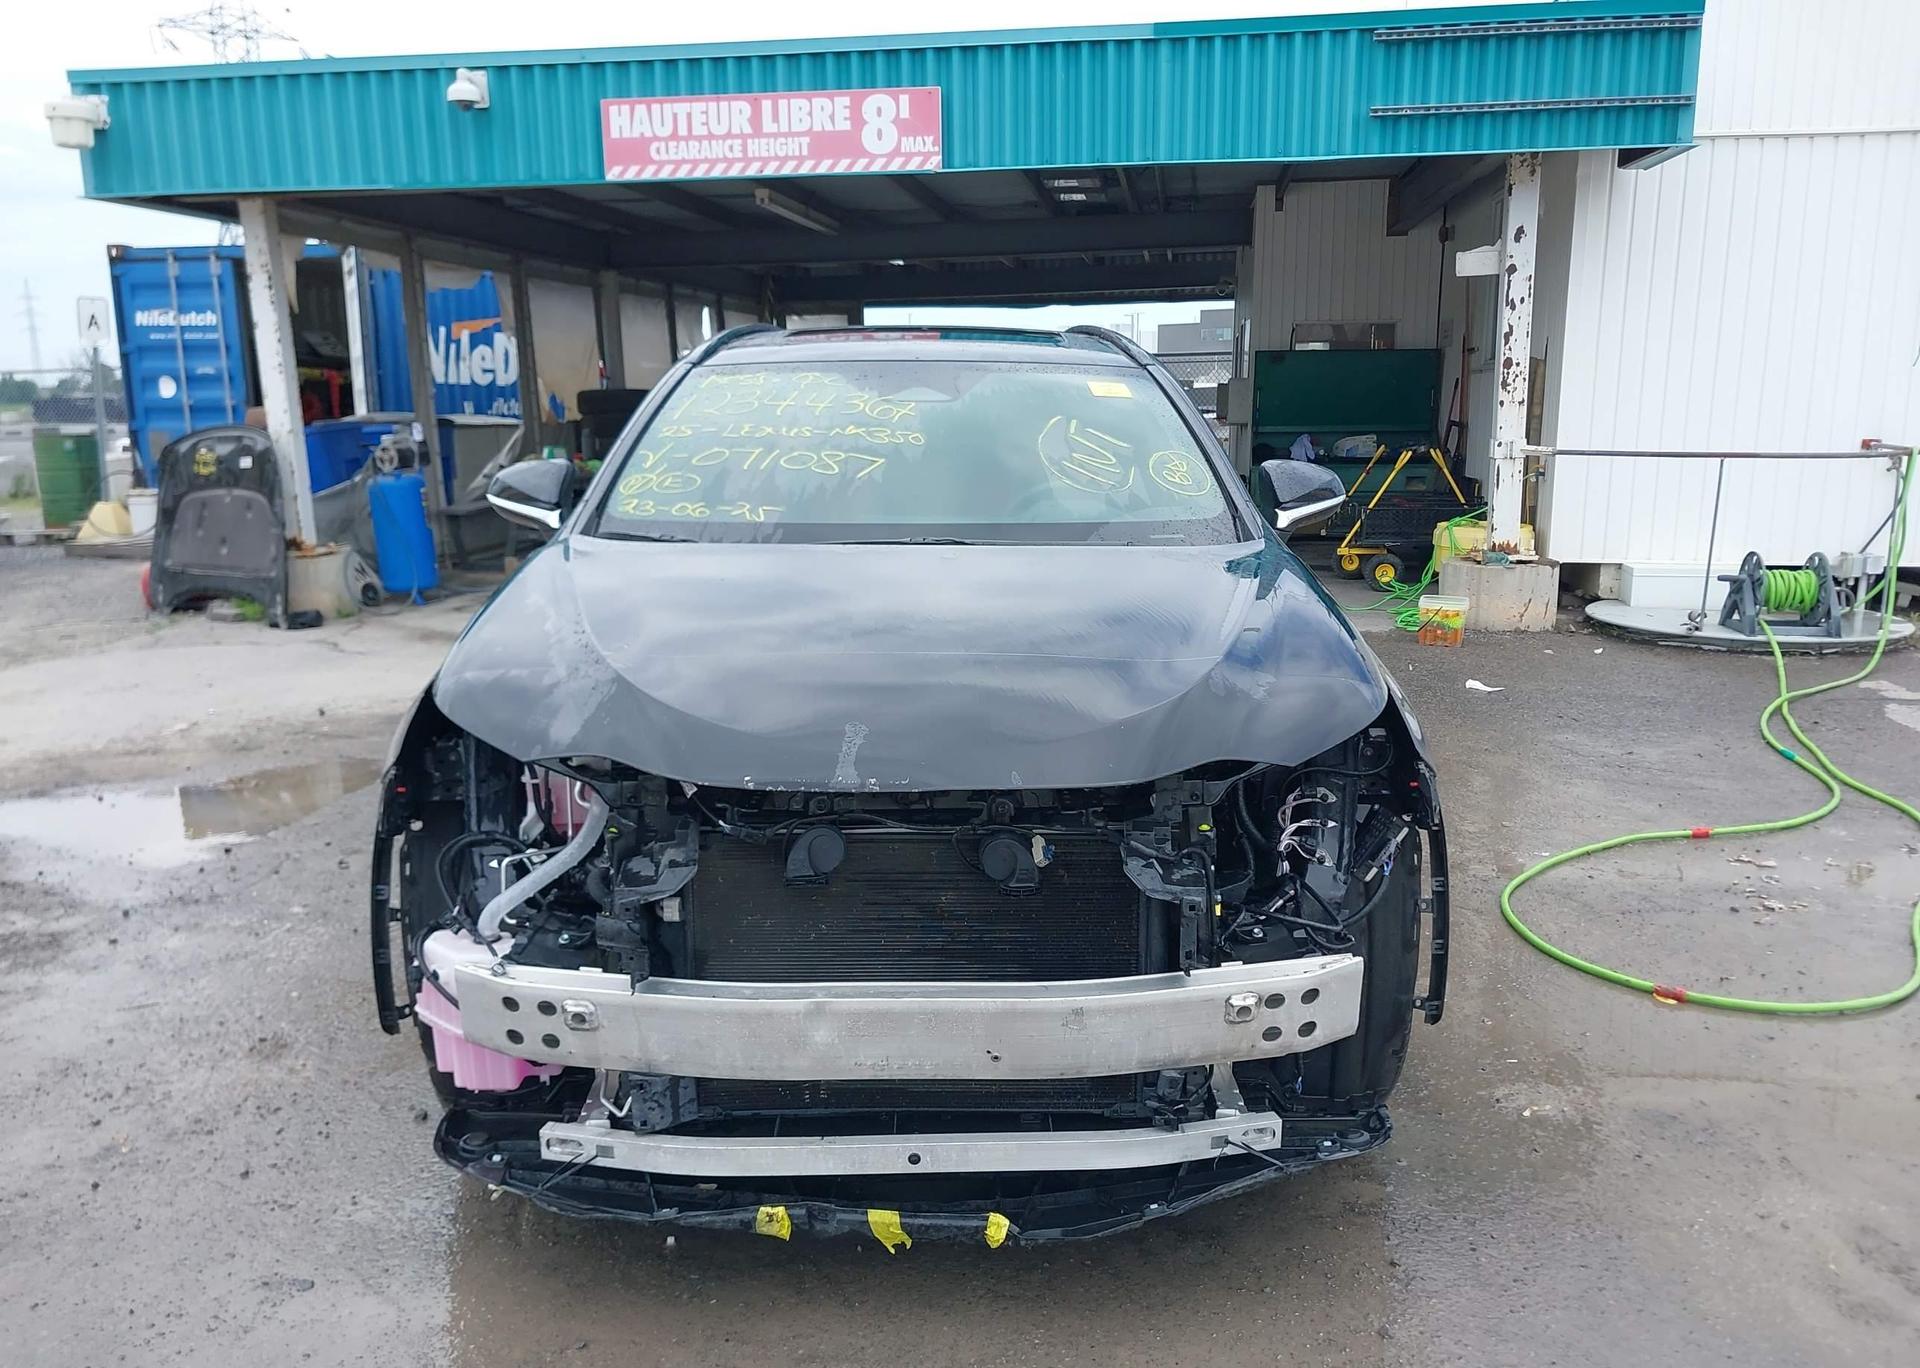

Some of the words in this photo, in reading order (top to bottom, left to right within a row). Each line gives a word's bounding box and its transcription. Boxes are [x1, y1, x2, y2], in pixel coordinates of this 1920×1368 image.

[608, 101, 753, 138] HAUTEUR
[761, 97, 852, 133] LIBRE
[649, 140, 743, 161] CLEARANCE
[747, 137, 811, 158] HEIGHT
[900, 135, 940, 153] MAX.
[88, 313, 101, 331] A
